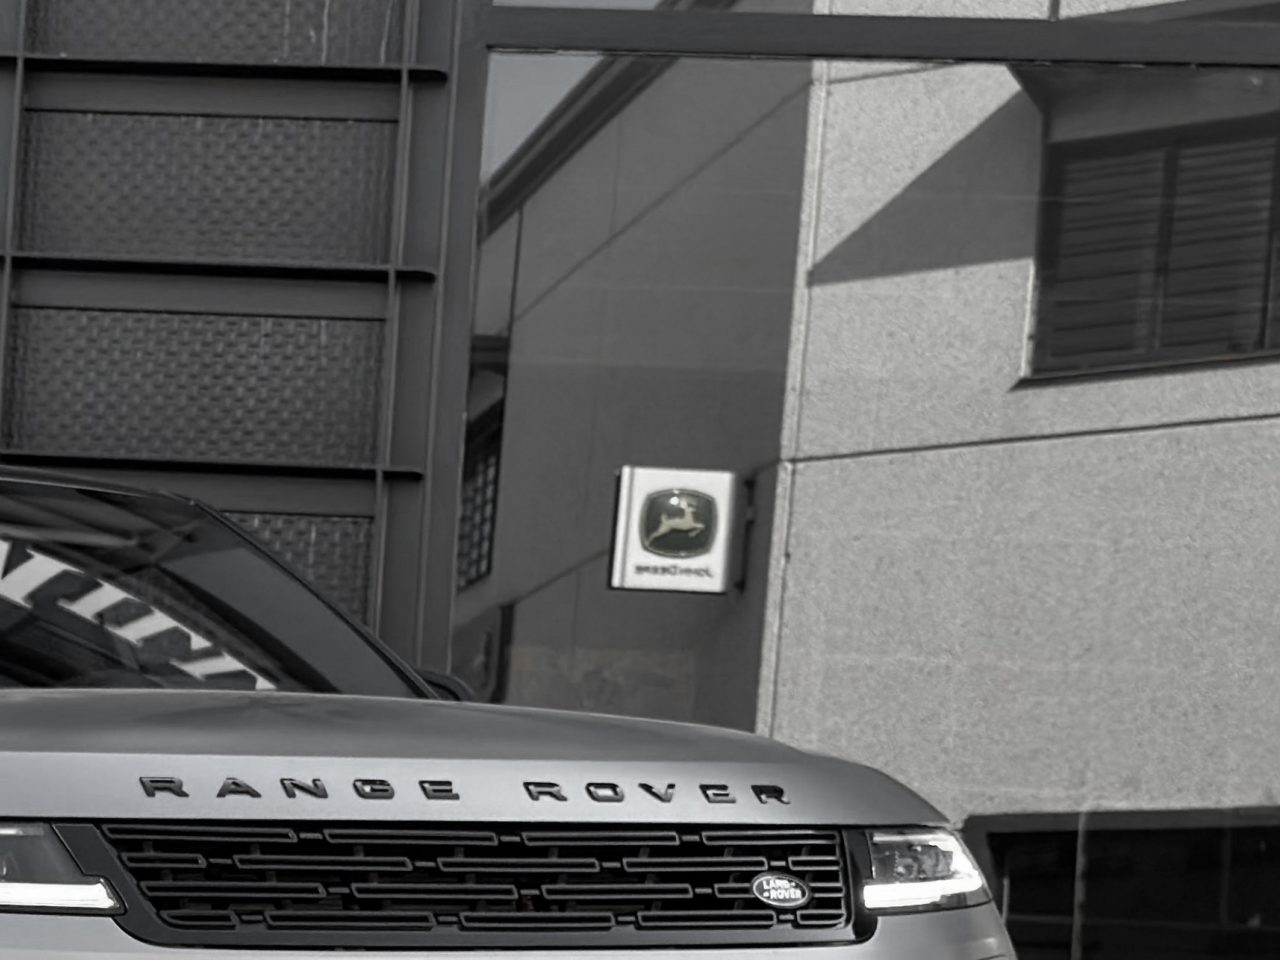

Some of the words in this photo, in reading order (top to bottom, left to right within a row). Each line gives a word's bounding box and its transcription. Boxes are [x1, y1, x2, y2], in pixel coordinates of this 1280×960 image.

[138, 776, 461, 801] RANGE
[522, 781, 792, 805] ROVER
[762, 879, 791, 890] LAND
[770, 888, 802, 900] ROVER
